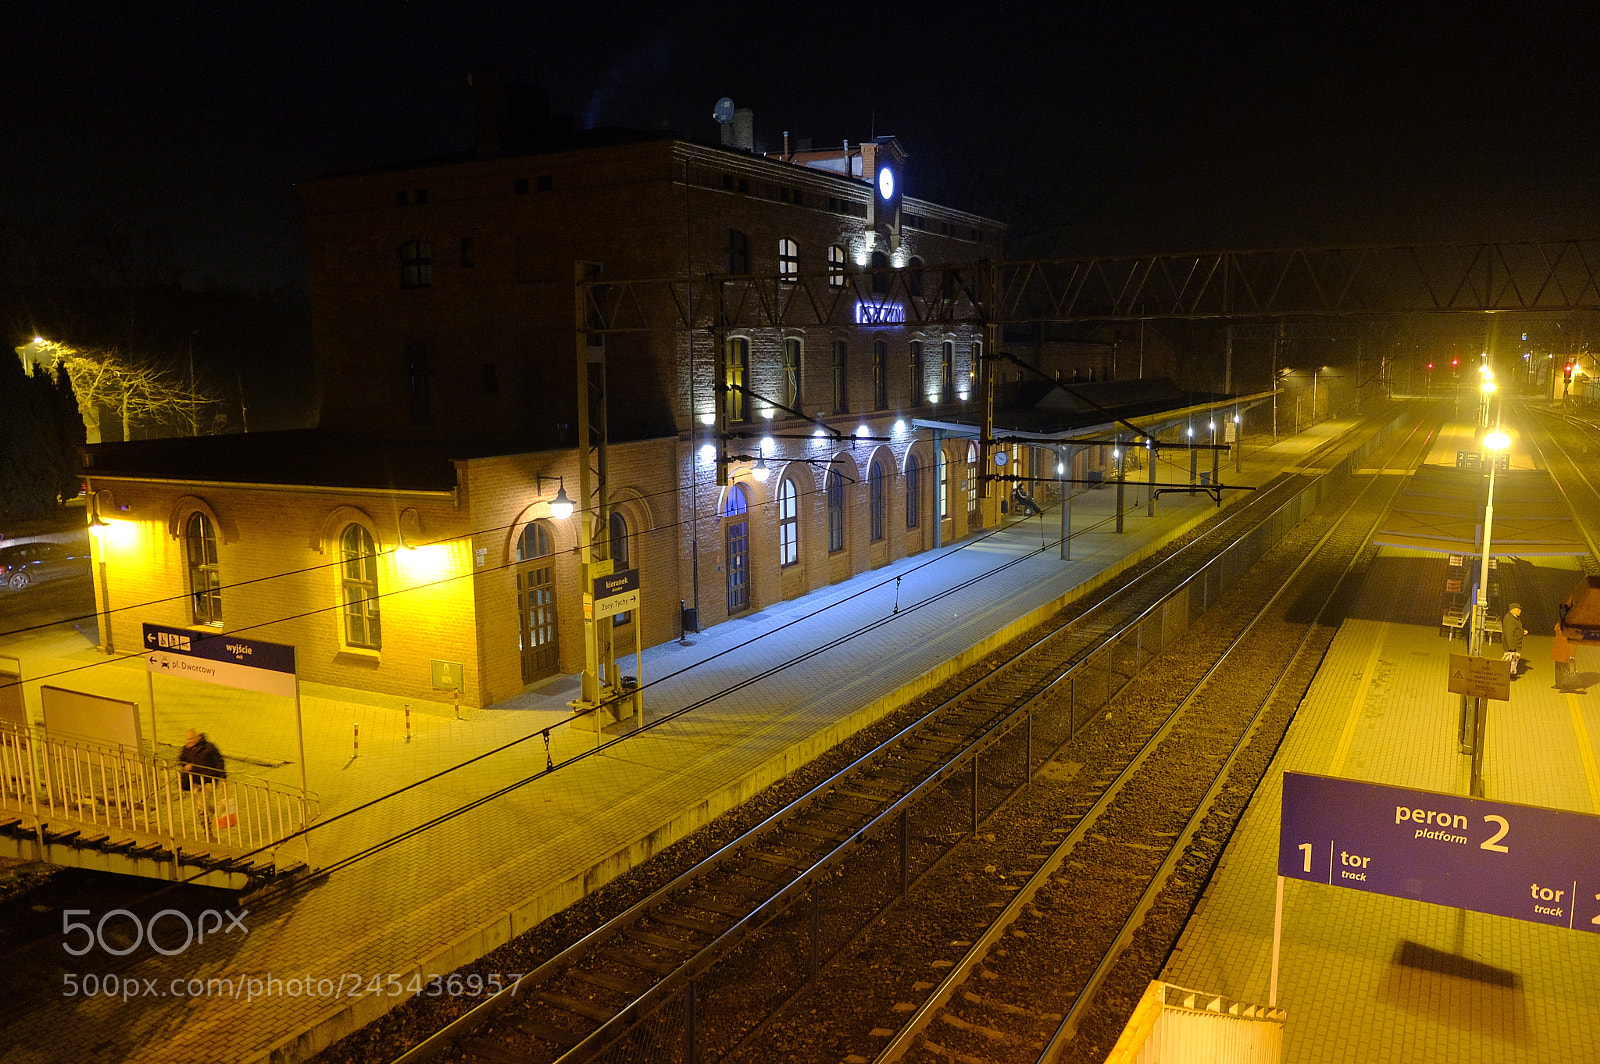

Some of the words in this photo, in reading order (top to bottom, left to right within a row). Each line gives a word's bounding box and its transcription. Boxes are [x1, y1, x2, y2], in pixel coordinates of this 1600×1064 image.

[1395, 806, 1468, 830] peron
[1479, 814, 1510, 854] 2
[1414, 828, 1468, 845] platform
[1298, 842, 1313, 873] 1
[1340, 851, 1372, 870] tor
[1341, 870, 1367, 882] track
[1530, 883, 1565, 903] tor
[1534, 904, 1564, 918] track
